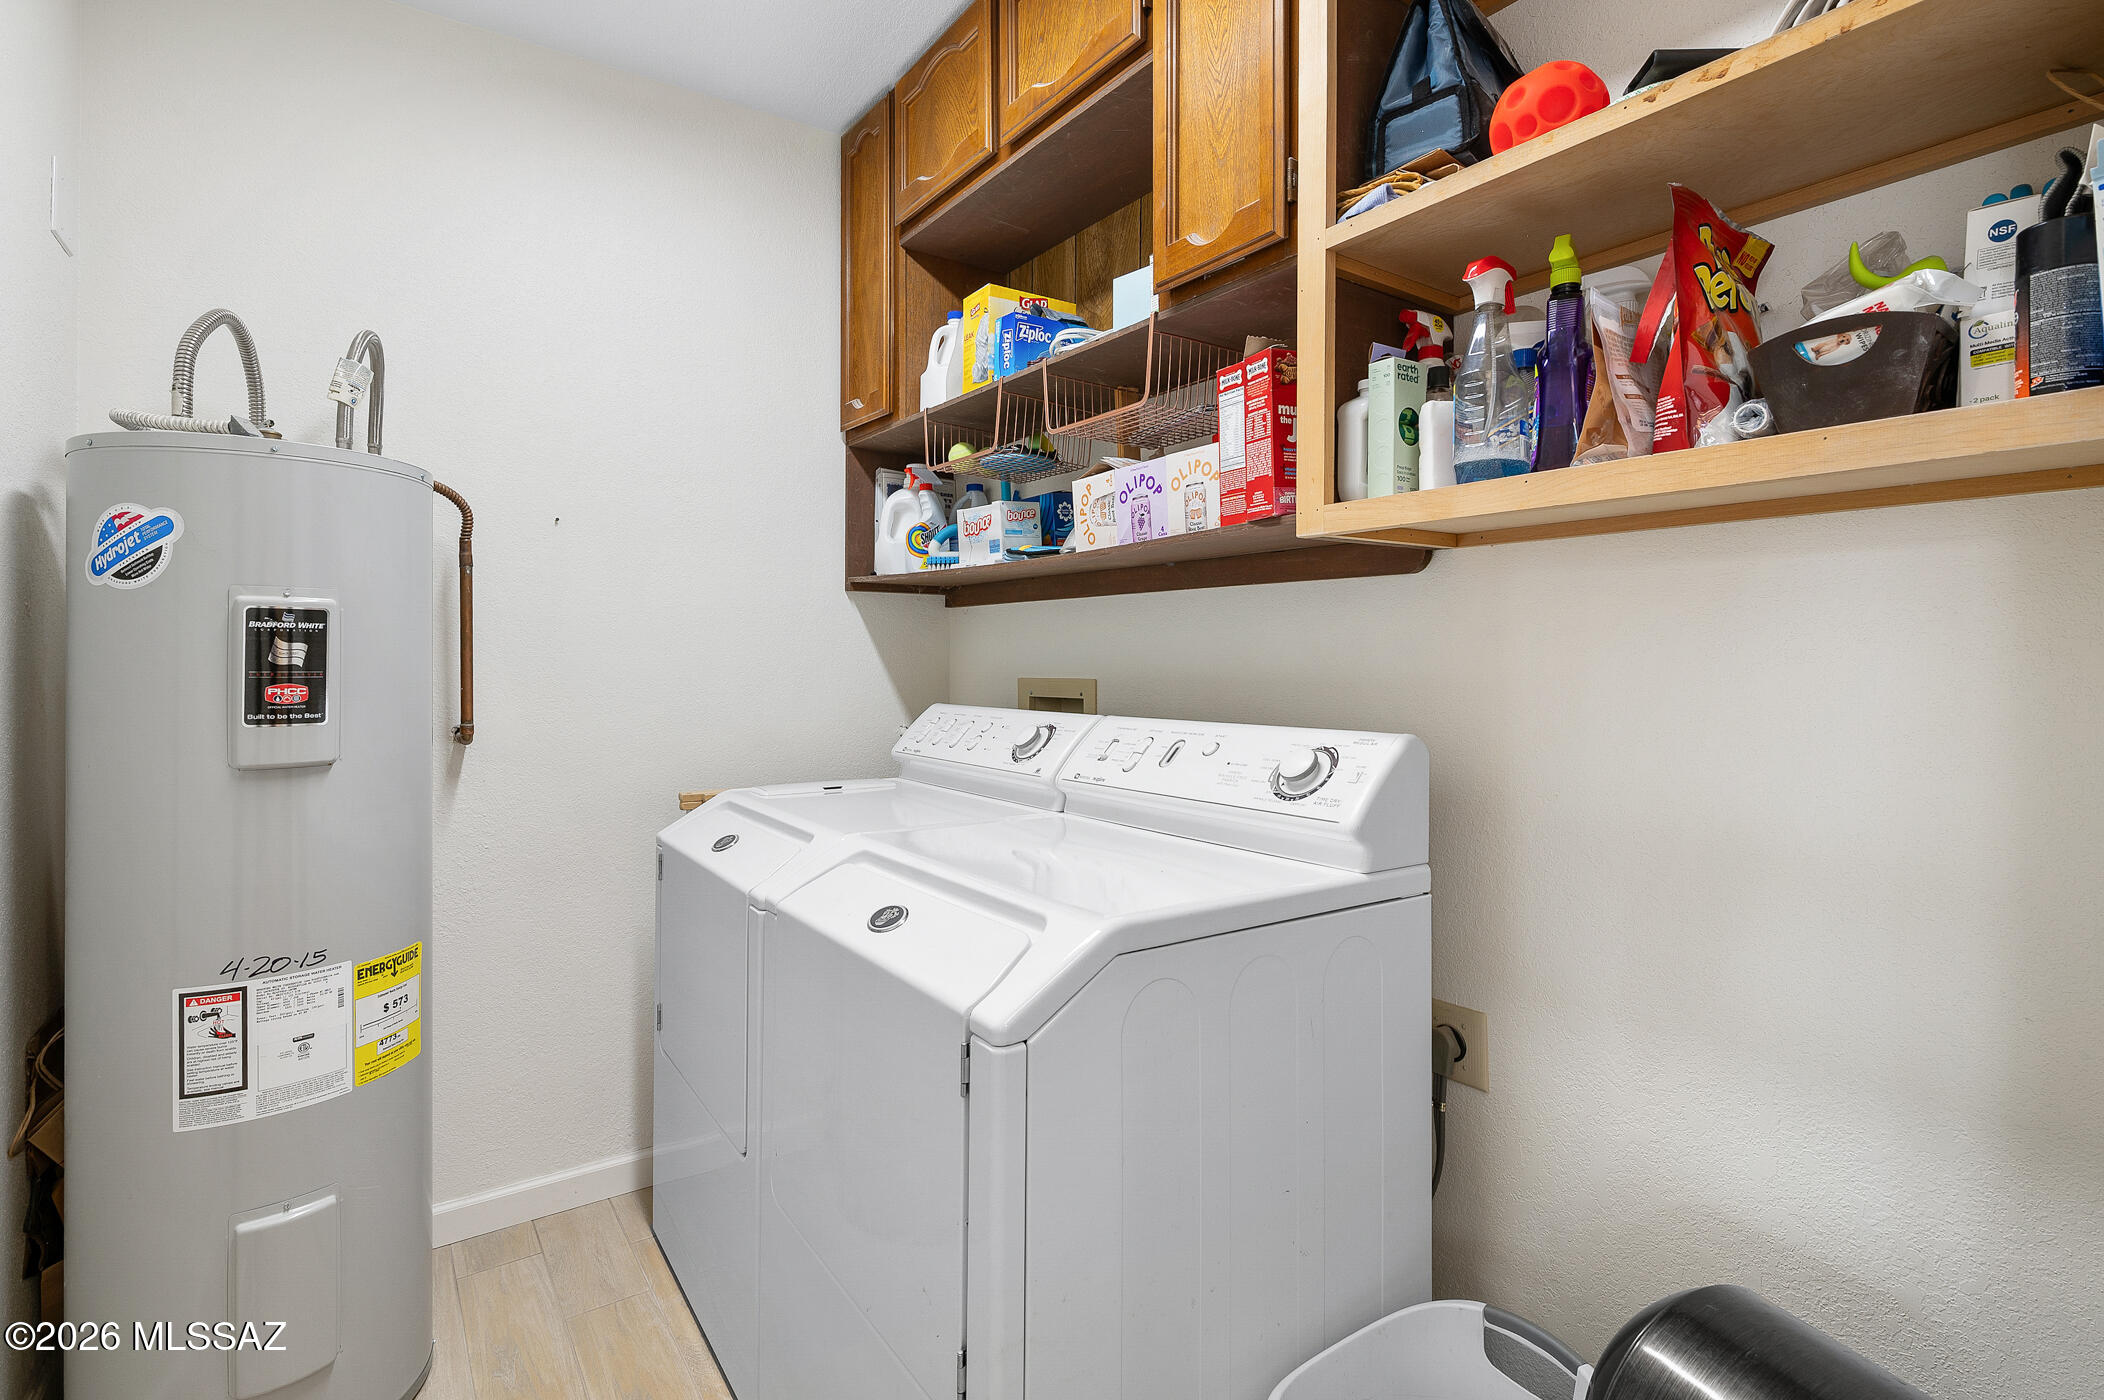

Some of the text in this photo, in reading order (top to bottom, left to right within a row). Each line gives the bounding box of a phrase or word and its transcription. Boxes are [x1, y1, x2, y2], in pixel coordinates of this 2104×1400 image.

[1988, 223, 2016, 238] NSF
[1019, 324, 1052, 343] Ziploc
[1002, 330, 1012, 369] Ziploc
[1855, 332, 1869, 352] WIPES
[1248, 361, 1267, 374] MILK-BONE
[1396, 363, 1419, 375] earth
[1221, 373, 1241, 386] MILK-BONE
[1396, 372, 1420, 384] rated
[1980, 394, 2000, 404] pack
[1280, 416, 1292, 425] the
[1171, 459, 1220, 491] OLIPOP
[1119, 473, 1163, 504] OLIPOP
[1006, 508, 1037, 522] bounce
[1080, 483, 1096, 545] OLIPOP
[963, 514, 992, 537] bounce
[920, 525, 940, 545] SHOUT
[94, 530, 142, 571] Hydrojet
[248, 620, 296, 629] BRADFORD
[267, 687, 307, 695] PHCC
[219, 948, 328, 981] 4-20-15
[356, 946, 419, 981] ENERGYGUIDE
[262, 976, 289, 985] AUTOMATIC
[289, 973, 310, 981] STORAGE
[199, 995, 233, 1005] DANGER
[383, 993, 409, 1013] $ 573
[379, 1033, 397, 1046] 4773
